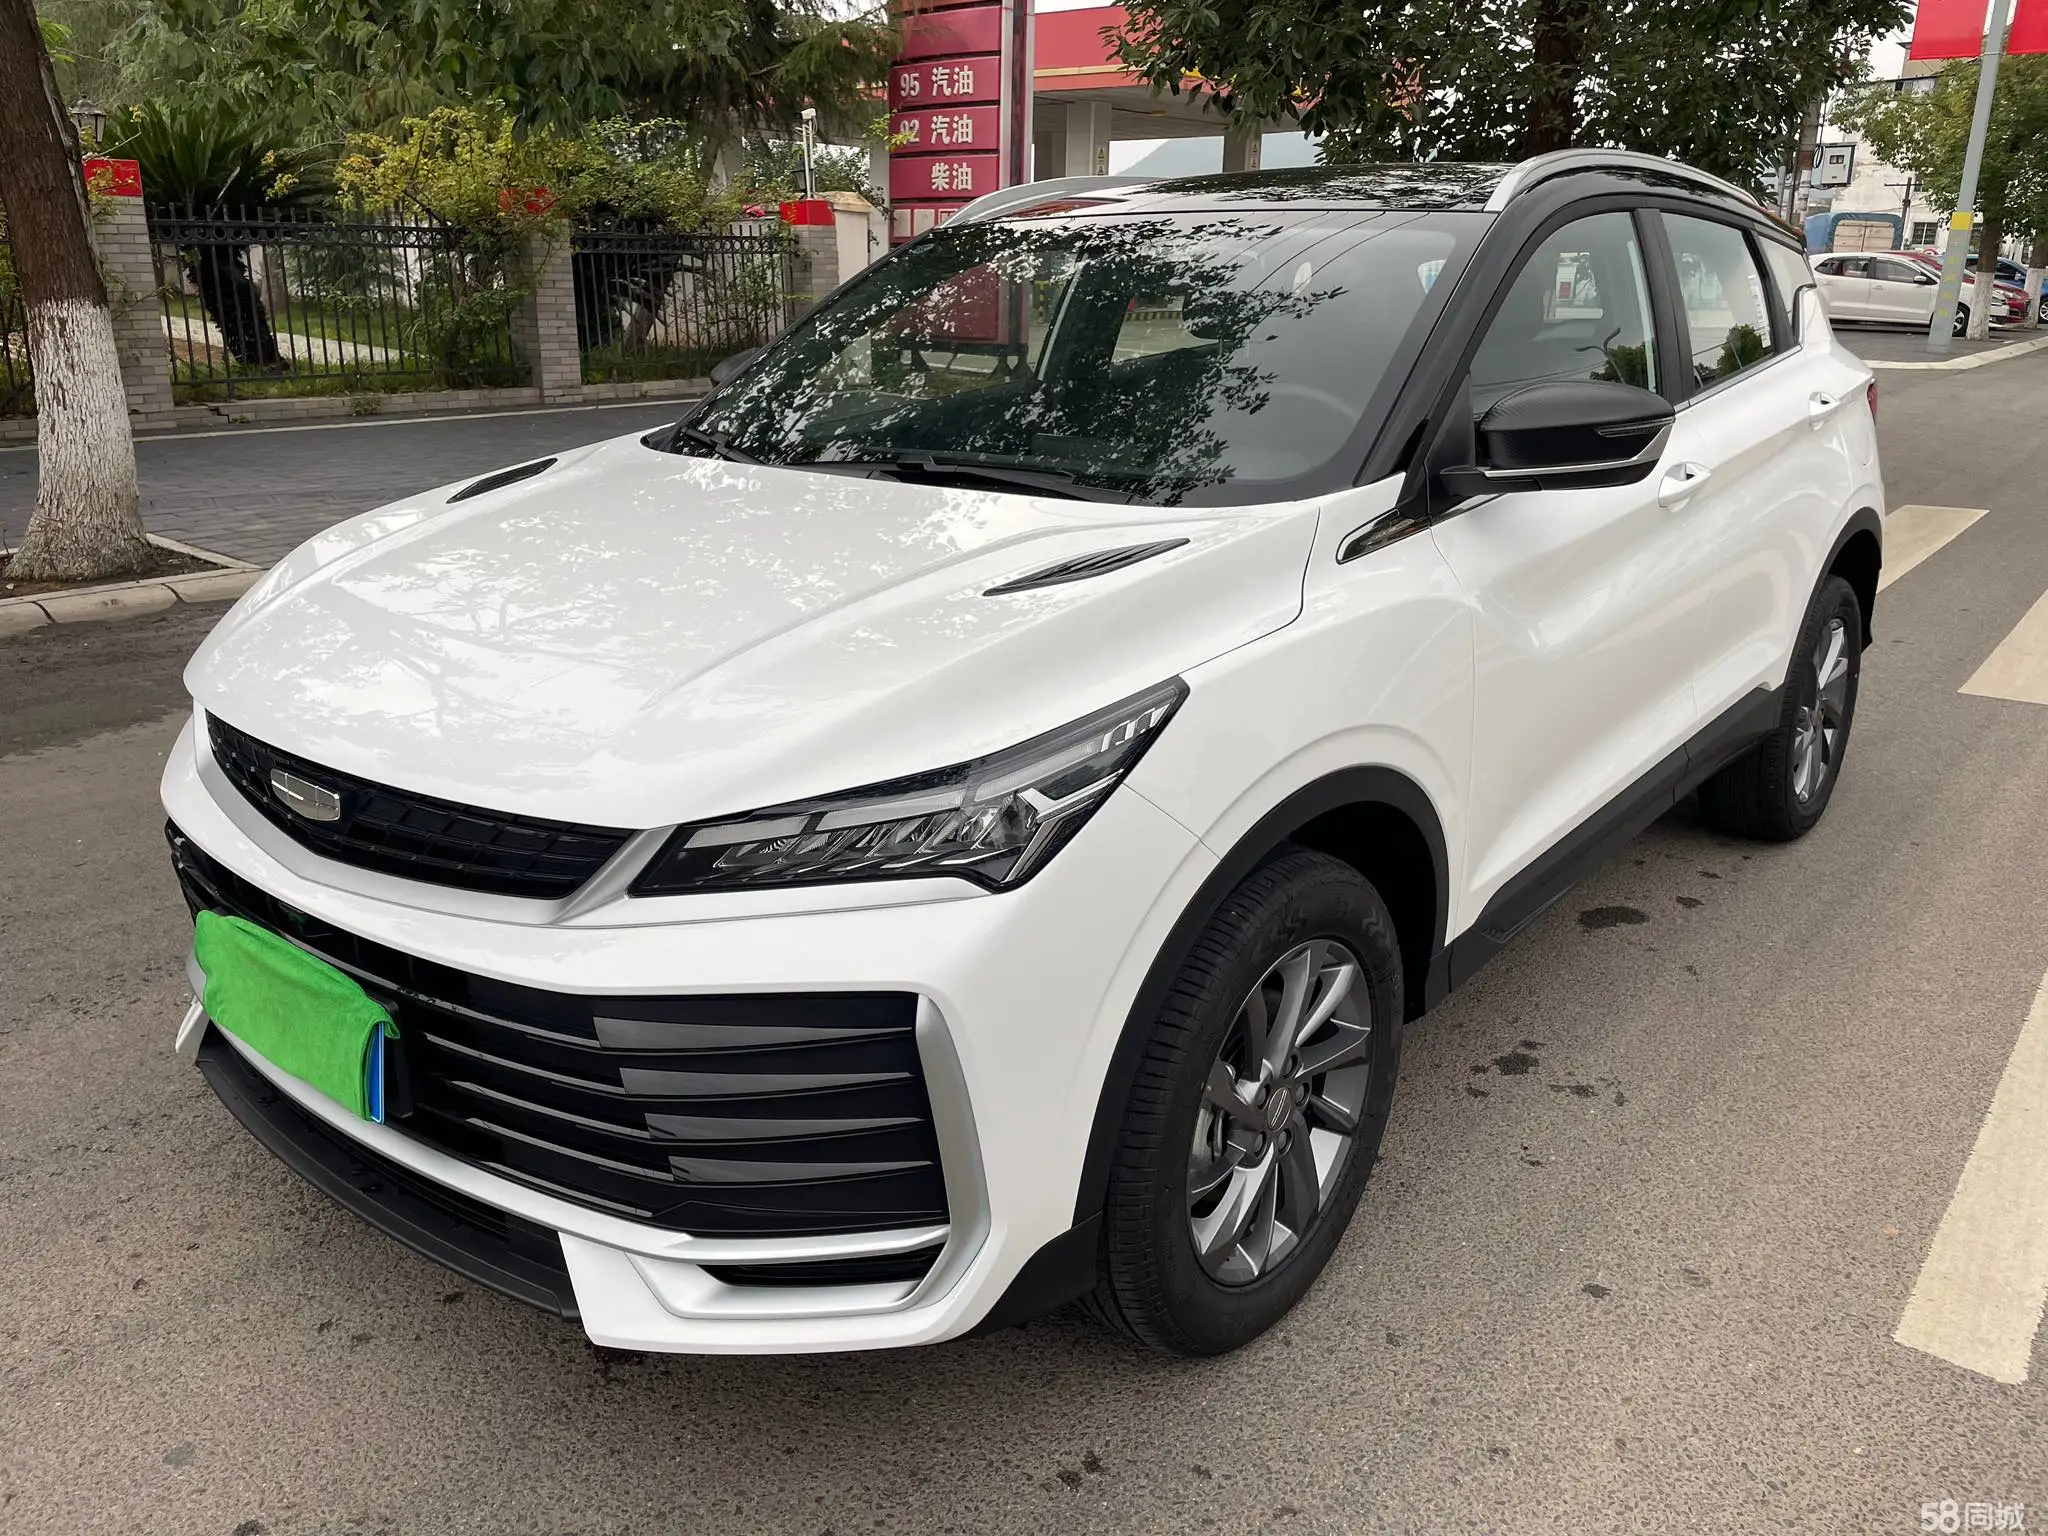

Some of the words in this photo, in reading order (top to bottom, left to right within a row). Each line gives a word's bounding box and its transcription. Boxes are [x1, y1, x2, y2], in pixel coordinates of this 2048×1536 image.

[900, 73, 920, 97] 95
[931, 65, 974, 97] 汽油
[931, 113, 973, 145] 汽油
[931, 161, 973, 192] 柴油
